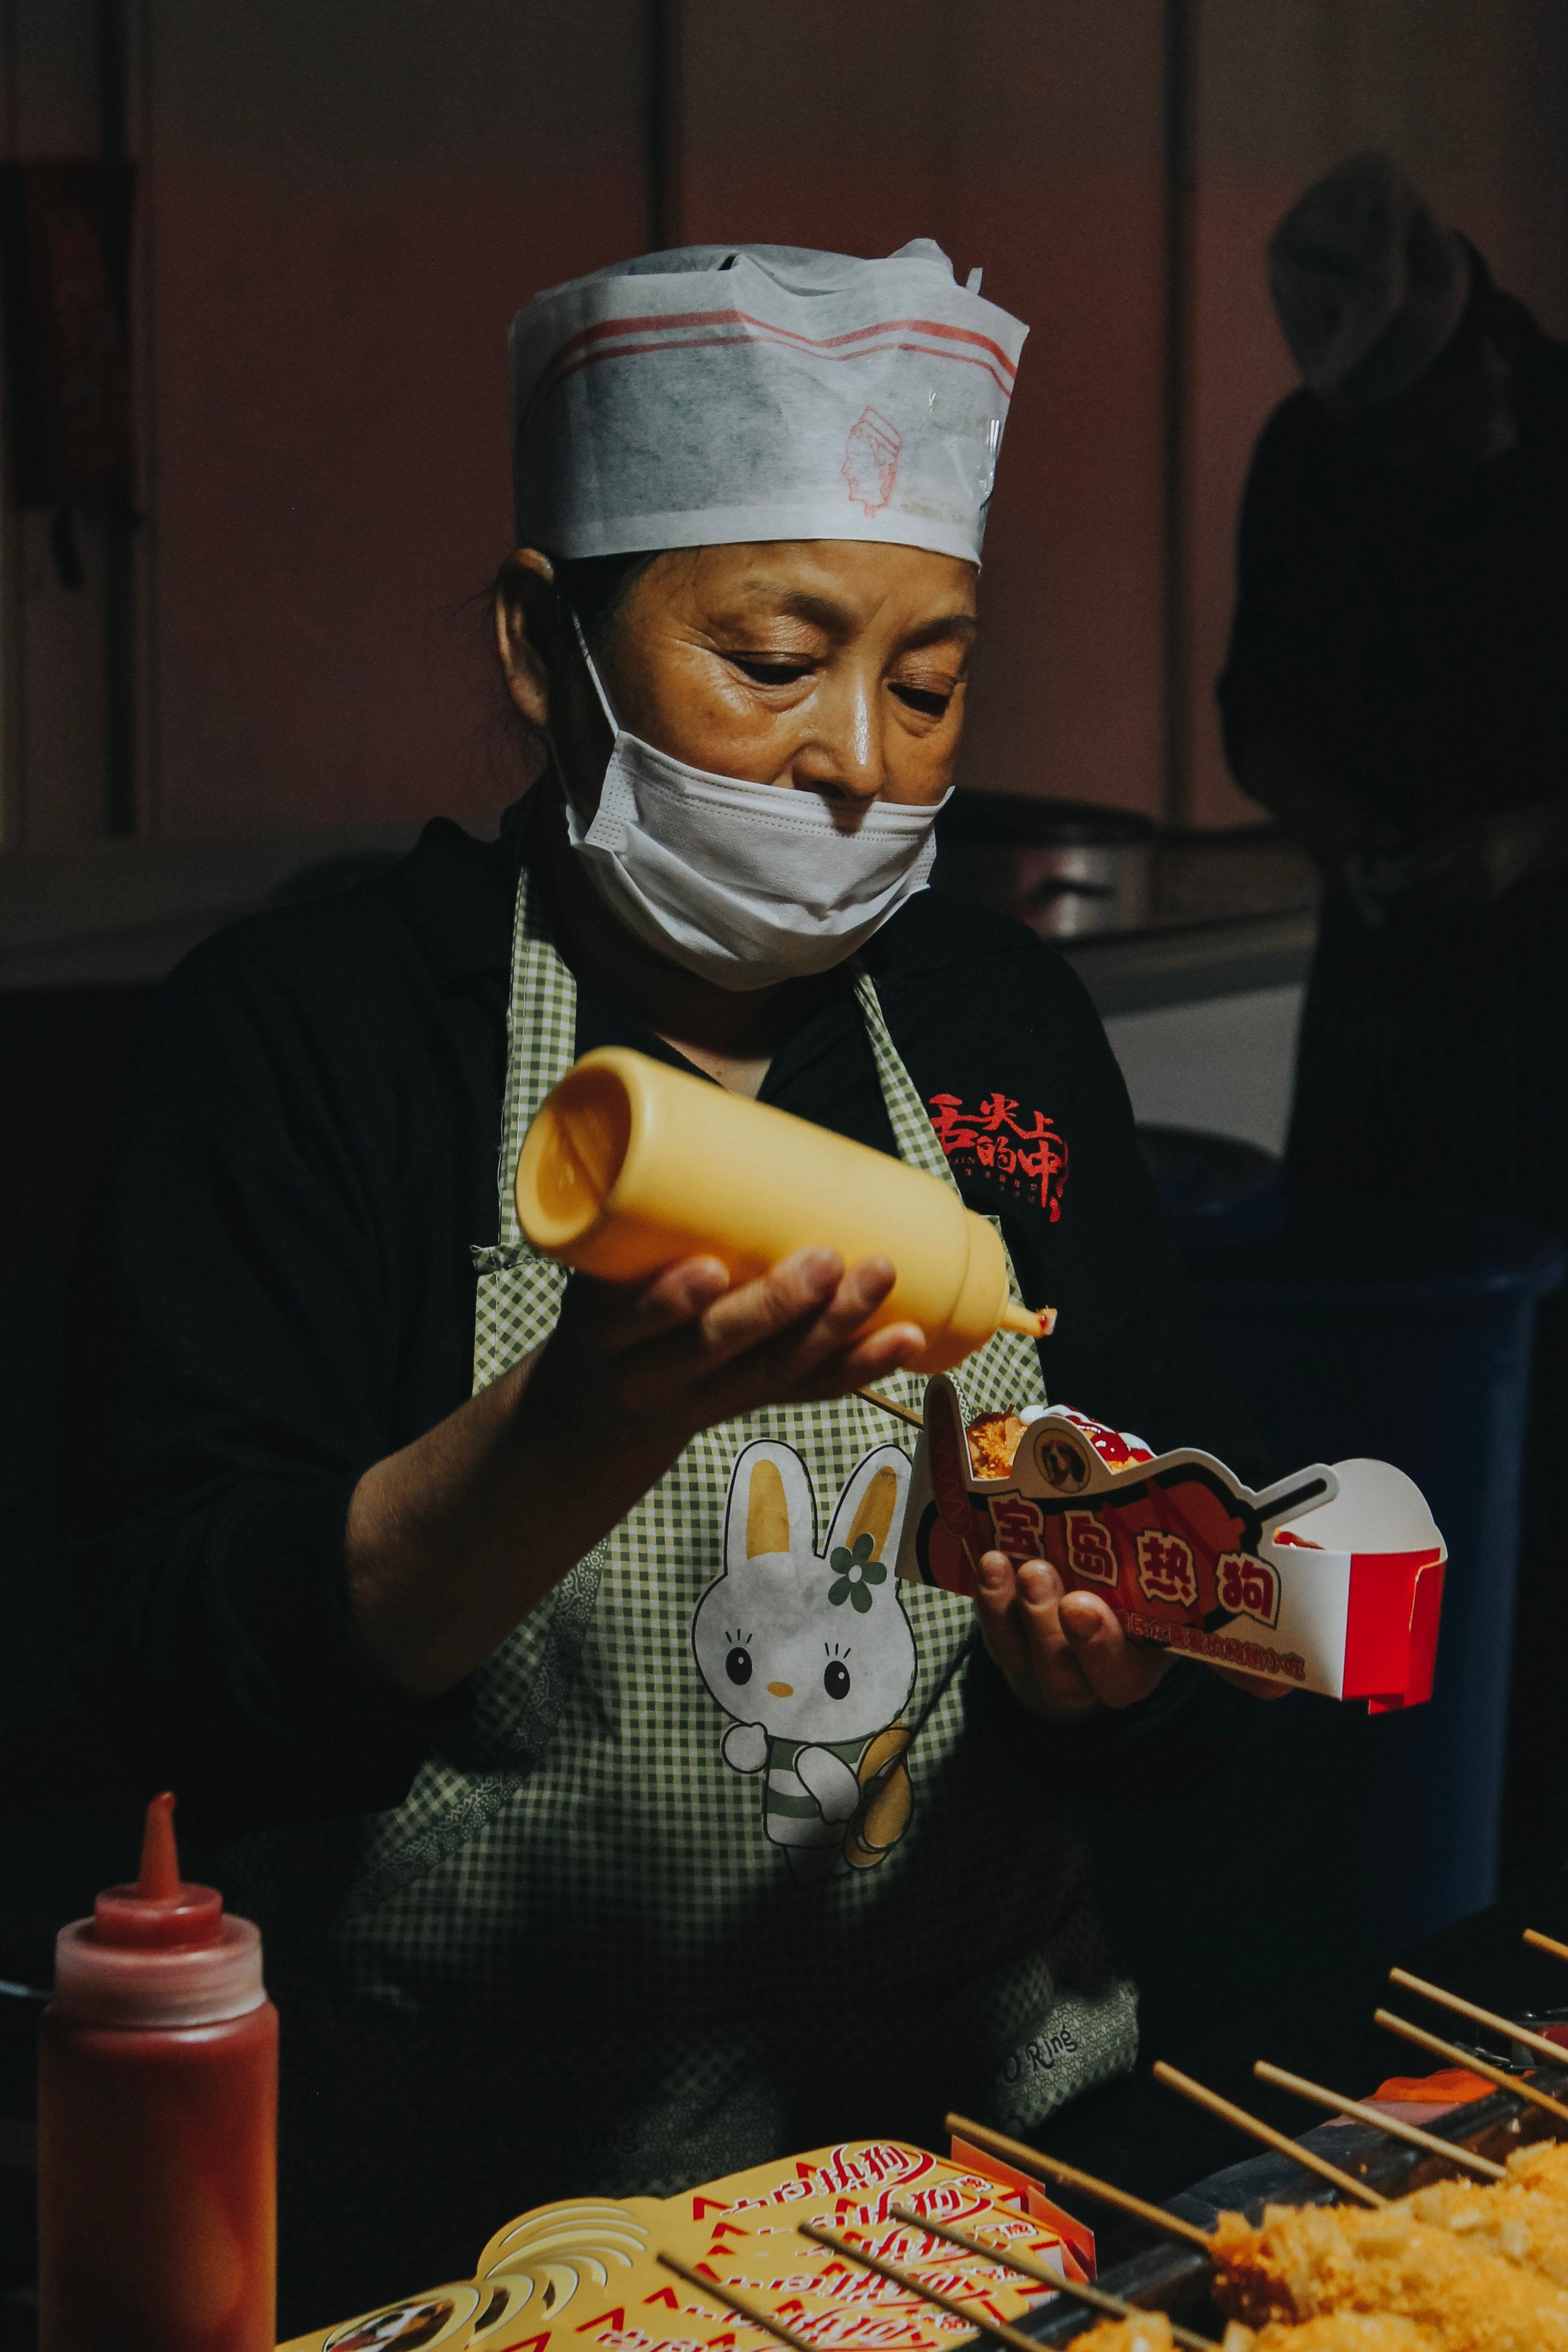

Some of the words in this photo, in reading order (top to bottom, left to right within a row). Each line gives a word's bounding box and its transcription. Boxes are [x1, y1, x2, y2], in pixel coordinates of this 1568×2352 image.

[989, 1494, 1276, 1624] 宝岛热狗
[1025, 2024, 1078, 2070] Ring
